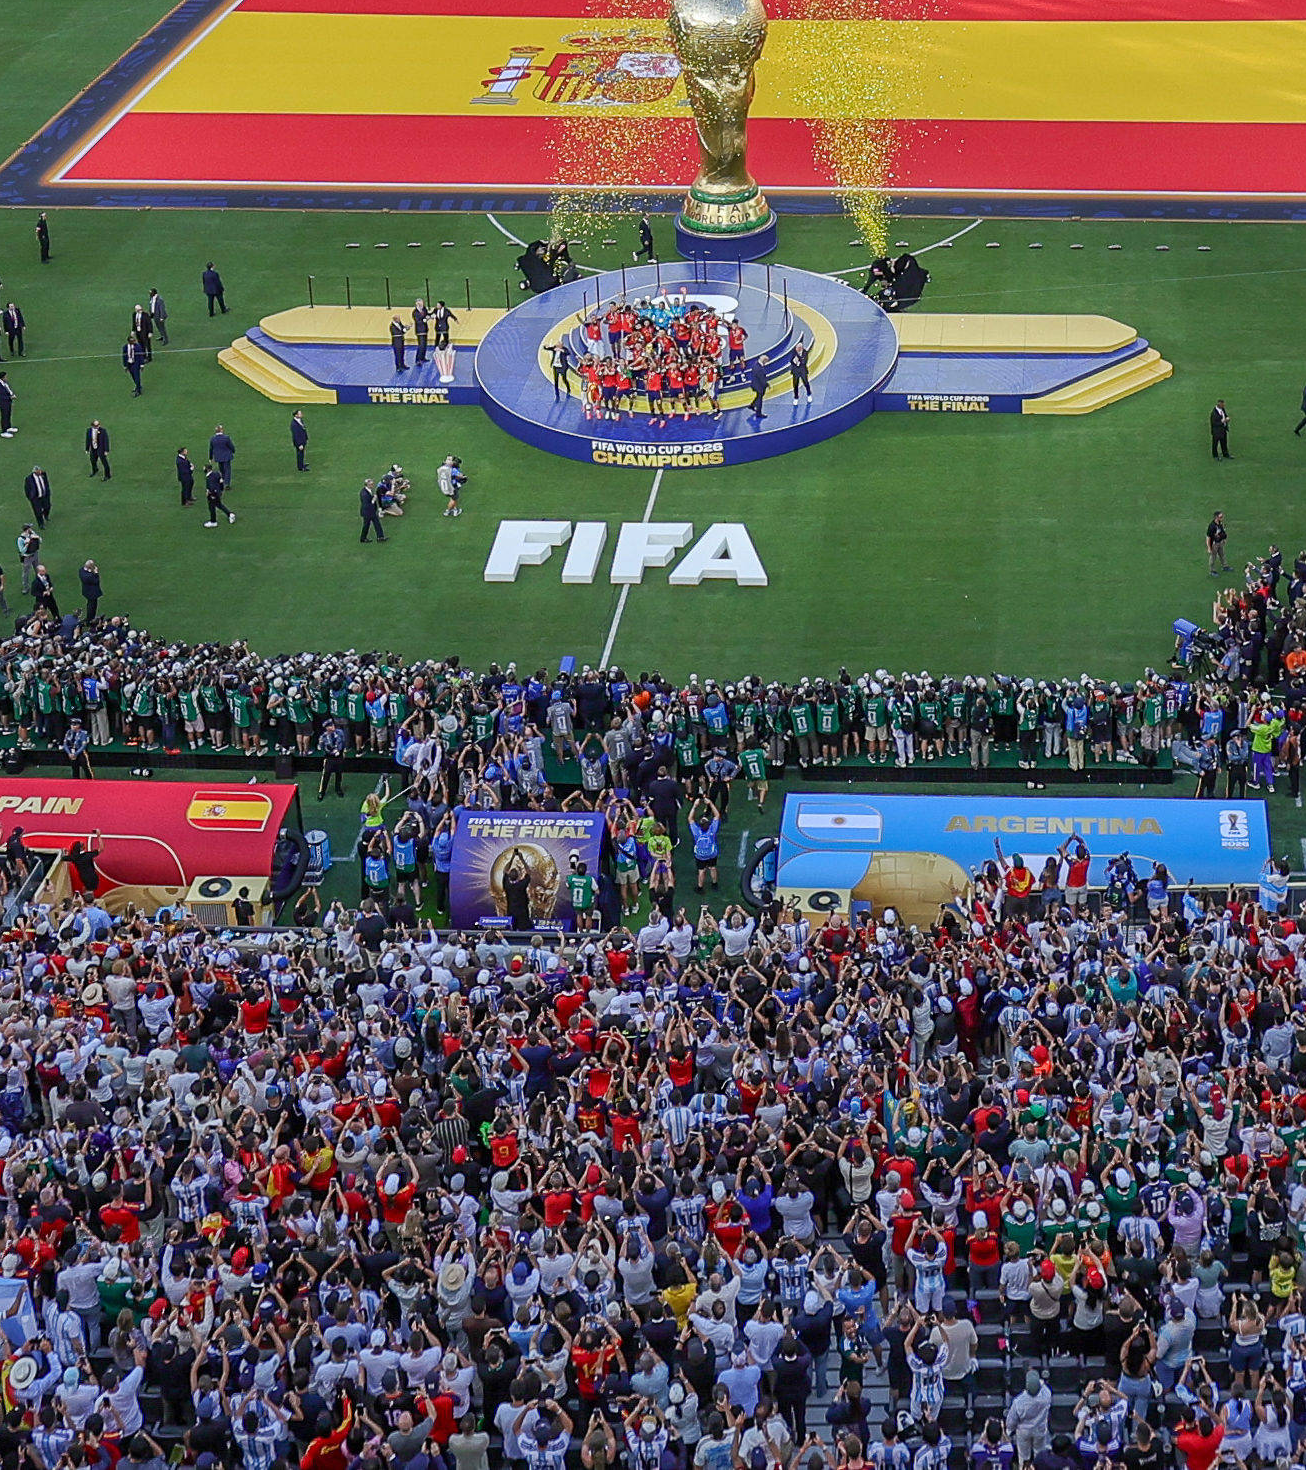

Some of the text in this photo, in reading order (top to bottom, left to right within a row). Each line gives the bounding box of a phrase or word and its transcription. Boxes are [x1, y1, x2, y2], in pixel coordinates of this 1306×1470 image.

[695, 202, 740, 214] FIFA
[690, 212, 750, 224] WORLD CUP
[369, 393, 449, 404] THE FINAL
[908, 401, 989, 411] THE FINAL
[592, 441, 723, 454] FIFA WORLD CUP 2026
[592, 451, 724, 467] CHAMPIONS
[483, 520, 768, 586] FIFA
[493, 818, 531, 826] WORLD
[944, 815, 1163, 835] ARGENTINA
[467, 825, 591, 839] THE FINAL
[498, 1145, 509, 1159] 9
[1150, 1197, 1167, 1213] 10
